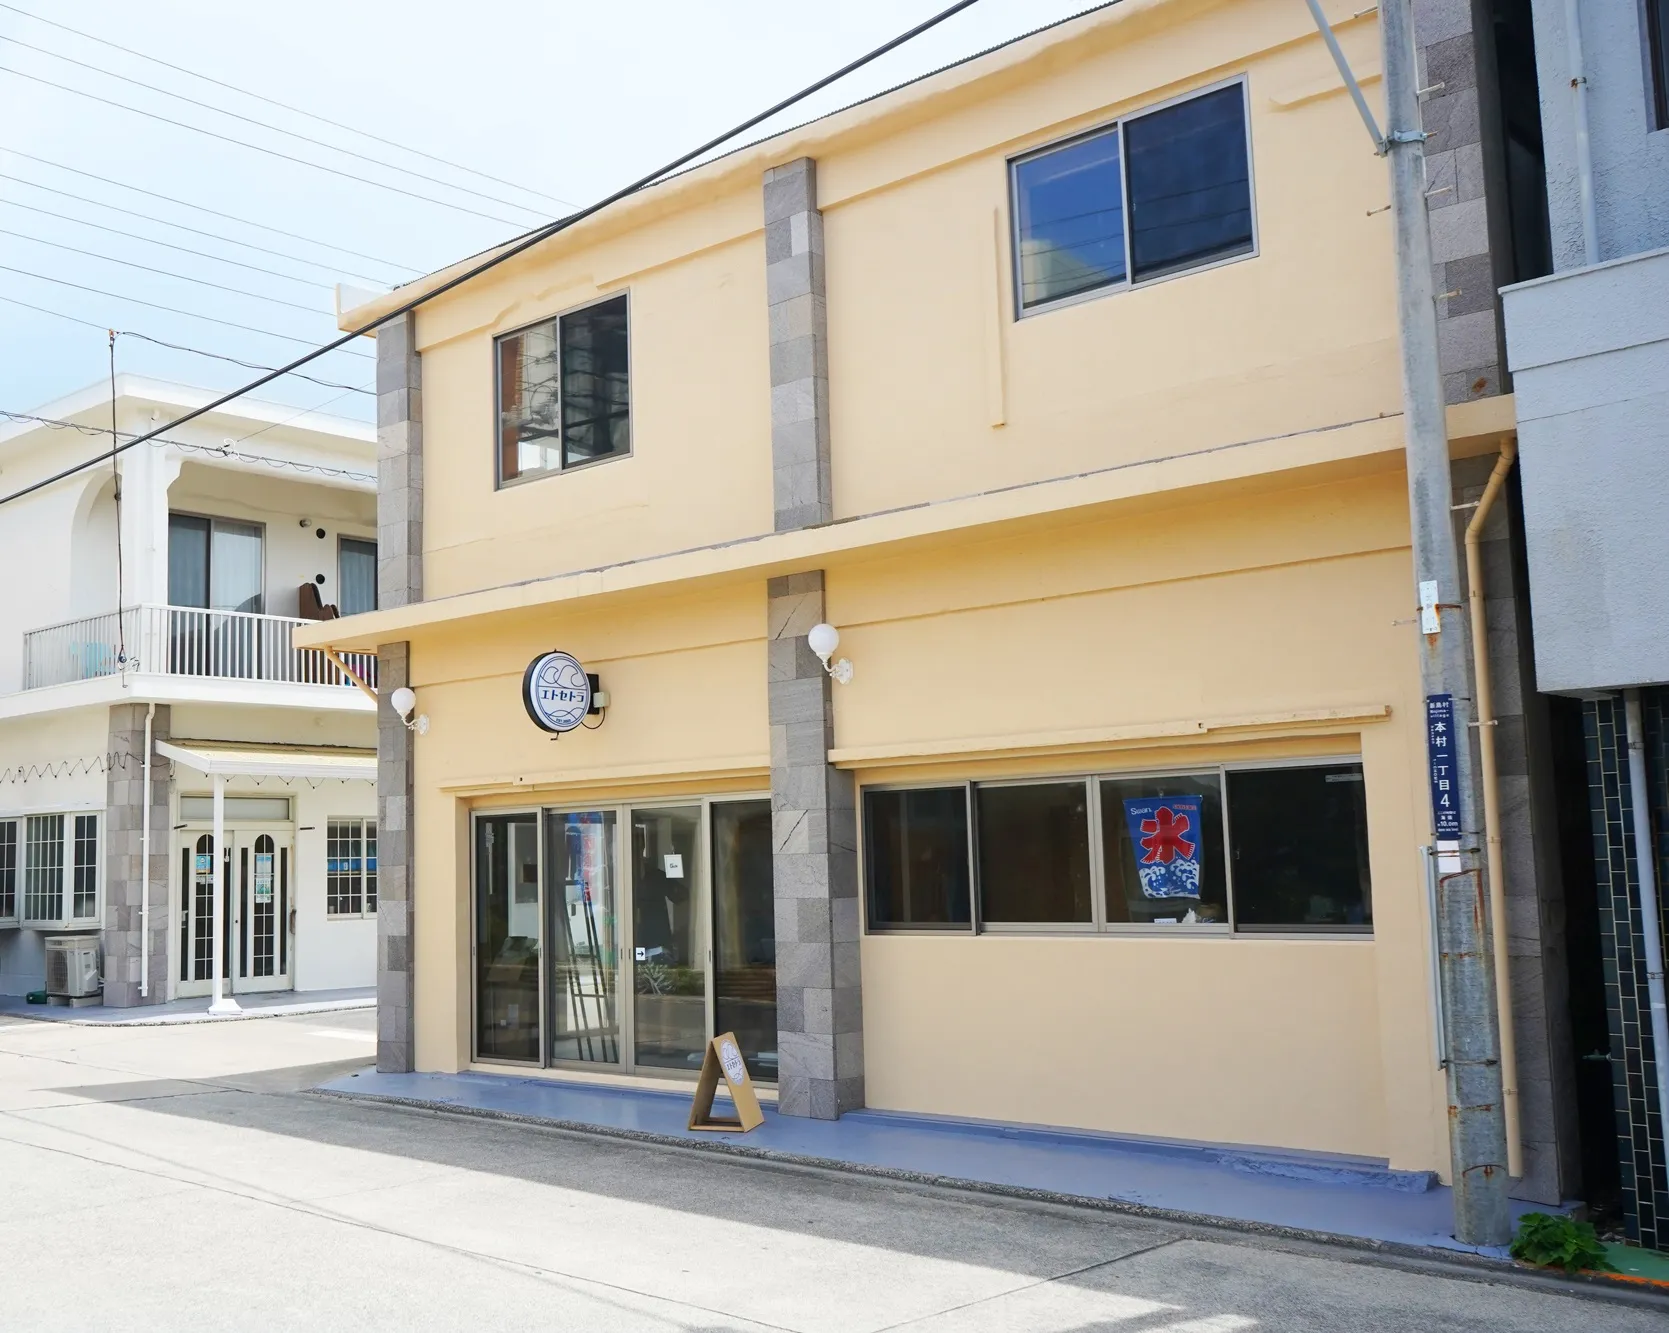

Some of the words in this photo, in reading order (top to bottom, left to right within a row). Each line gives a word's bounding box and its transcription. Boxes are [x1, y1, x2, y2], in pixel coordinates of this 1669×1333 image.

[541, 689, 584, 703] エトセトラ
[1434, 721, 1451, 808] 本村一丁目4
[1140, 806, 1195, 865] 氷
